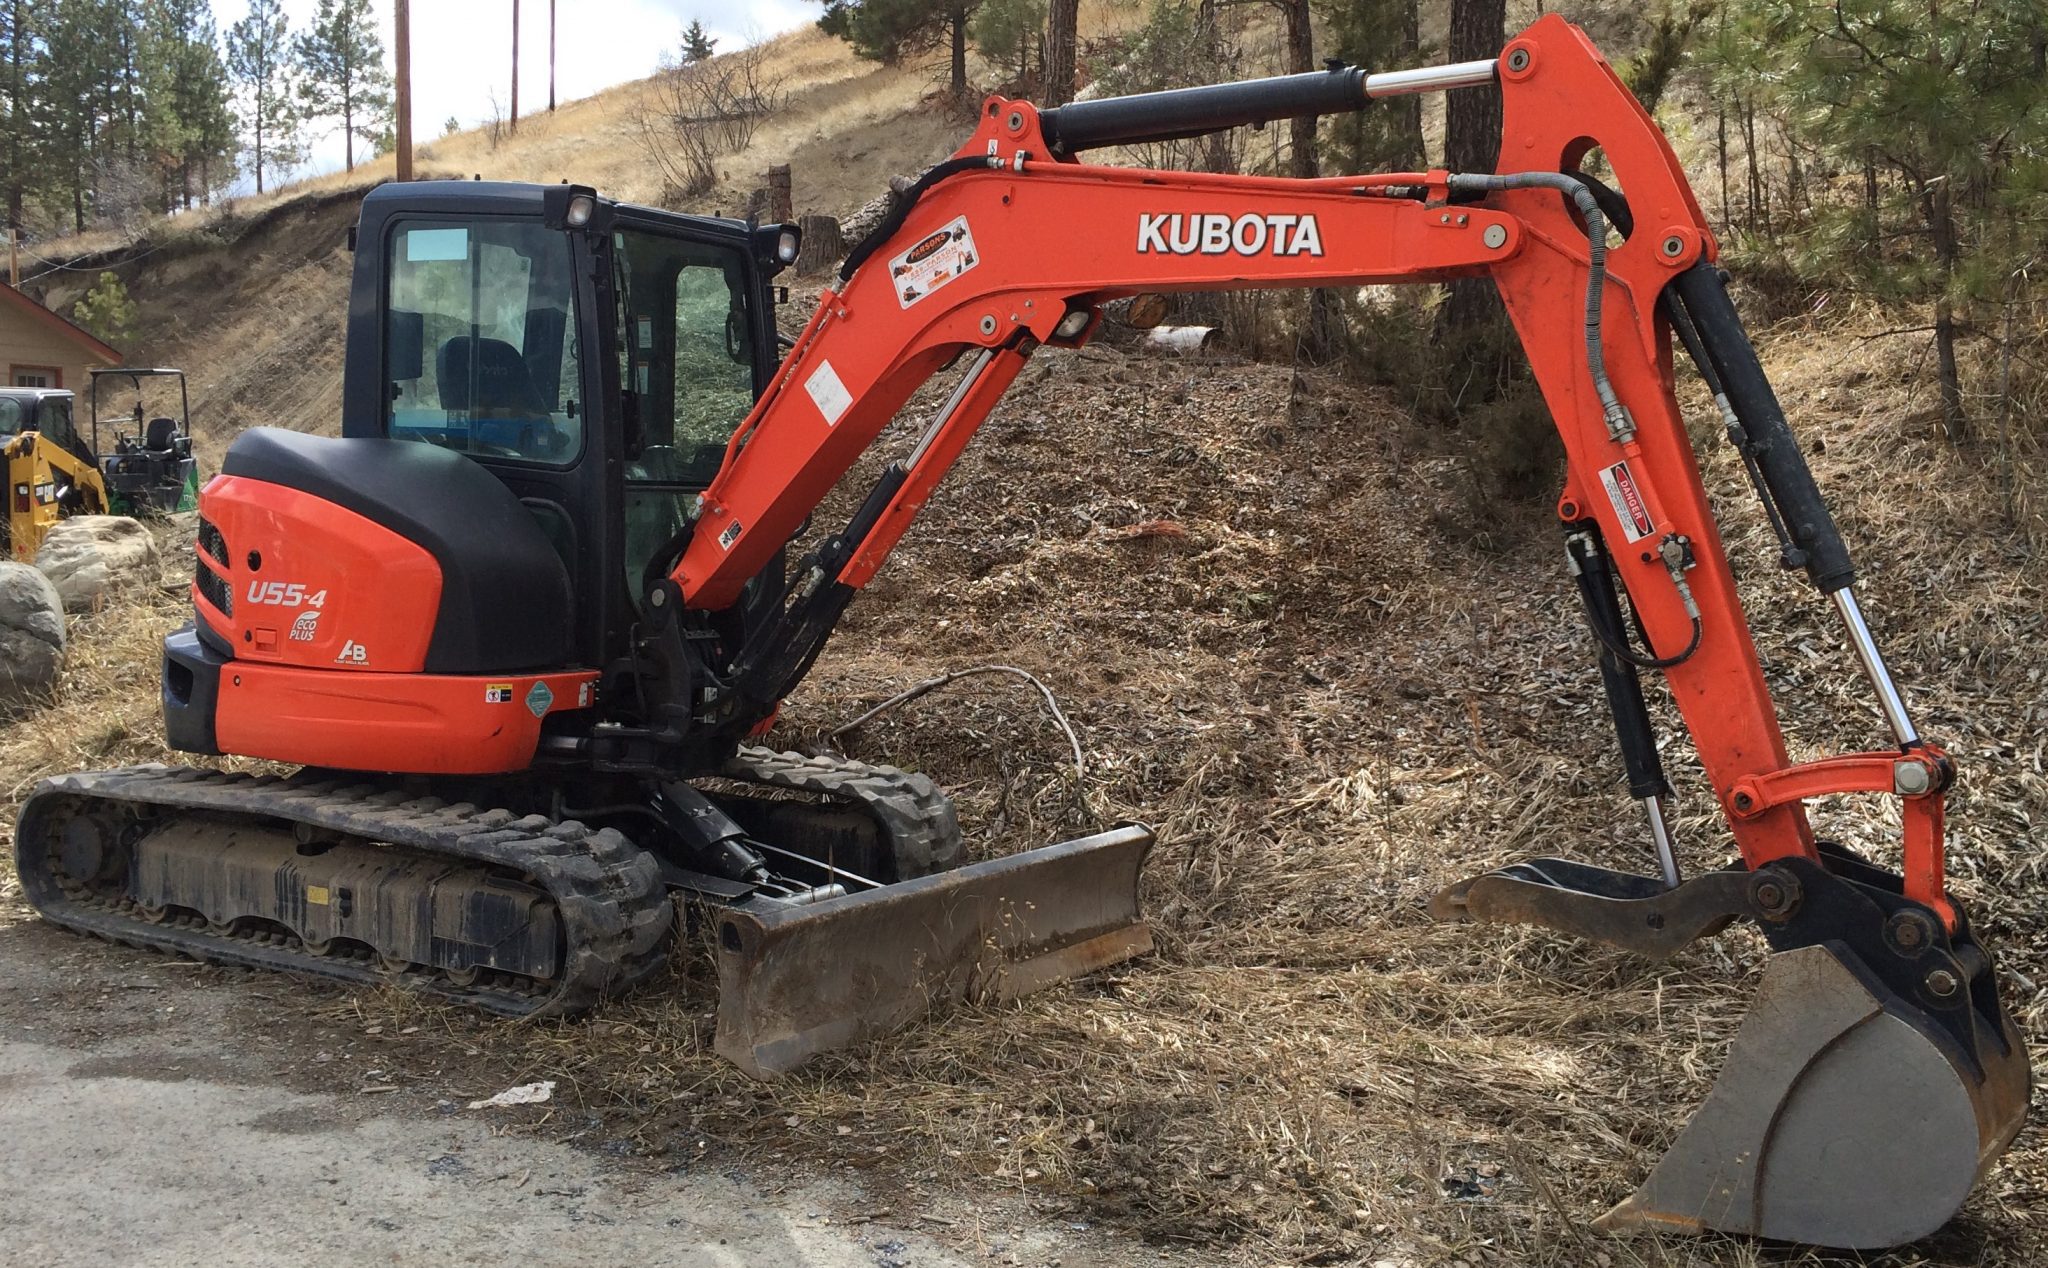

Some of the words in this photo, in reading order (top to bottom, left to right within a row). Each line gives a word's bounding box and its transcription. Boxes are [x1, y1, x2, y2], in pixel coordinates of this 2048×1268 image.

[910, 232, 947, 260] PARSONS
[1137, 213, 1324, 256] KUBOTA
[1620, 480, 1643, 520] DANGER
[247, 580, 327, 608] U55-4
[289, 629, 316, 641] PLUS
[337, 639, 367, 661] AB
